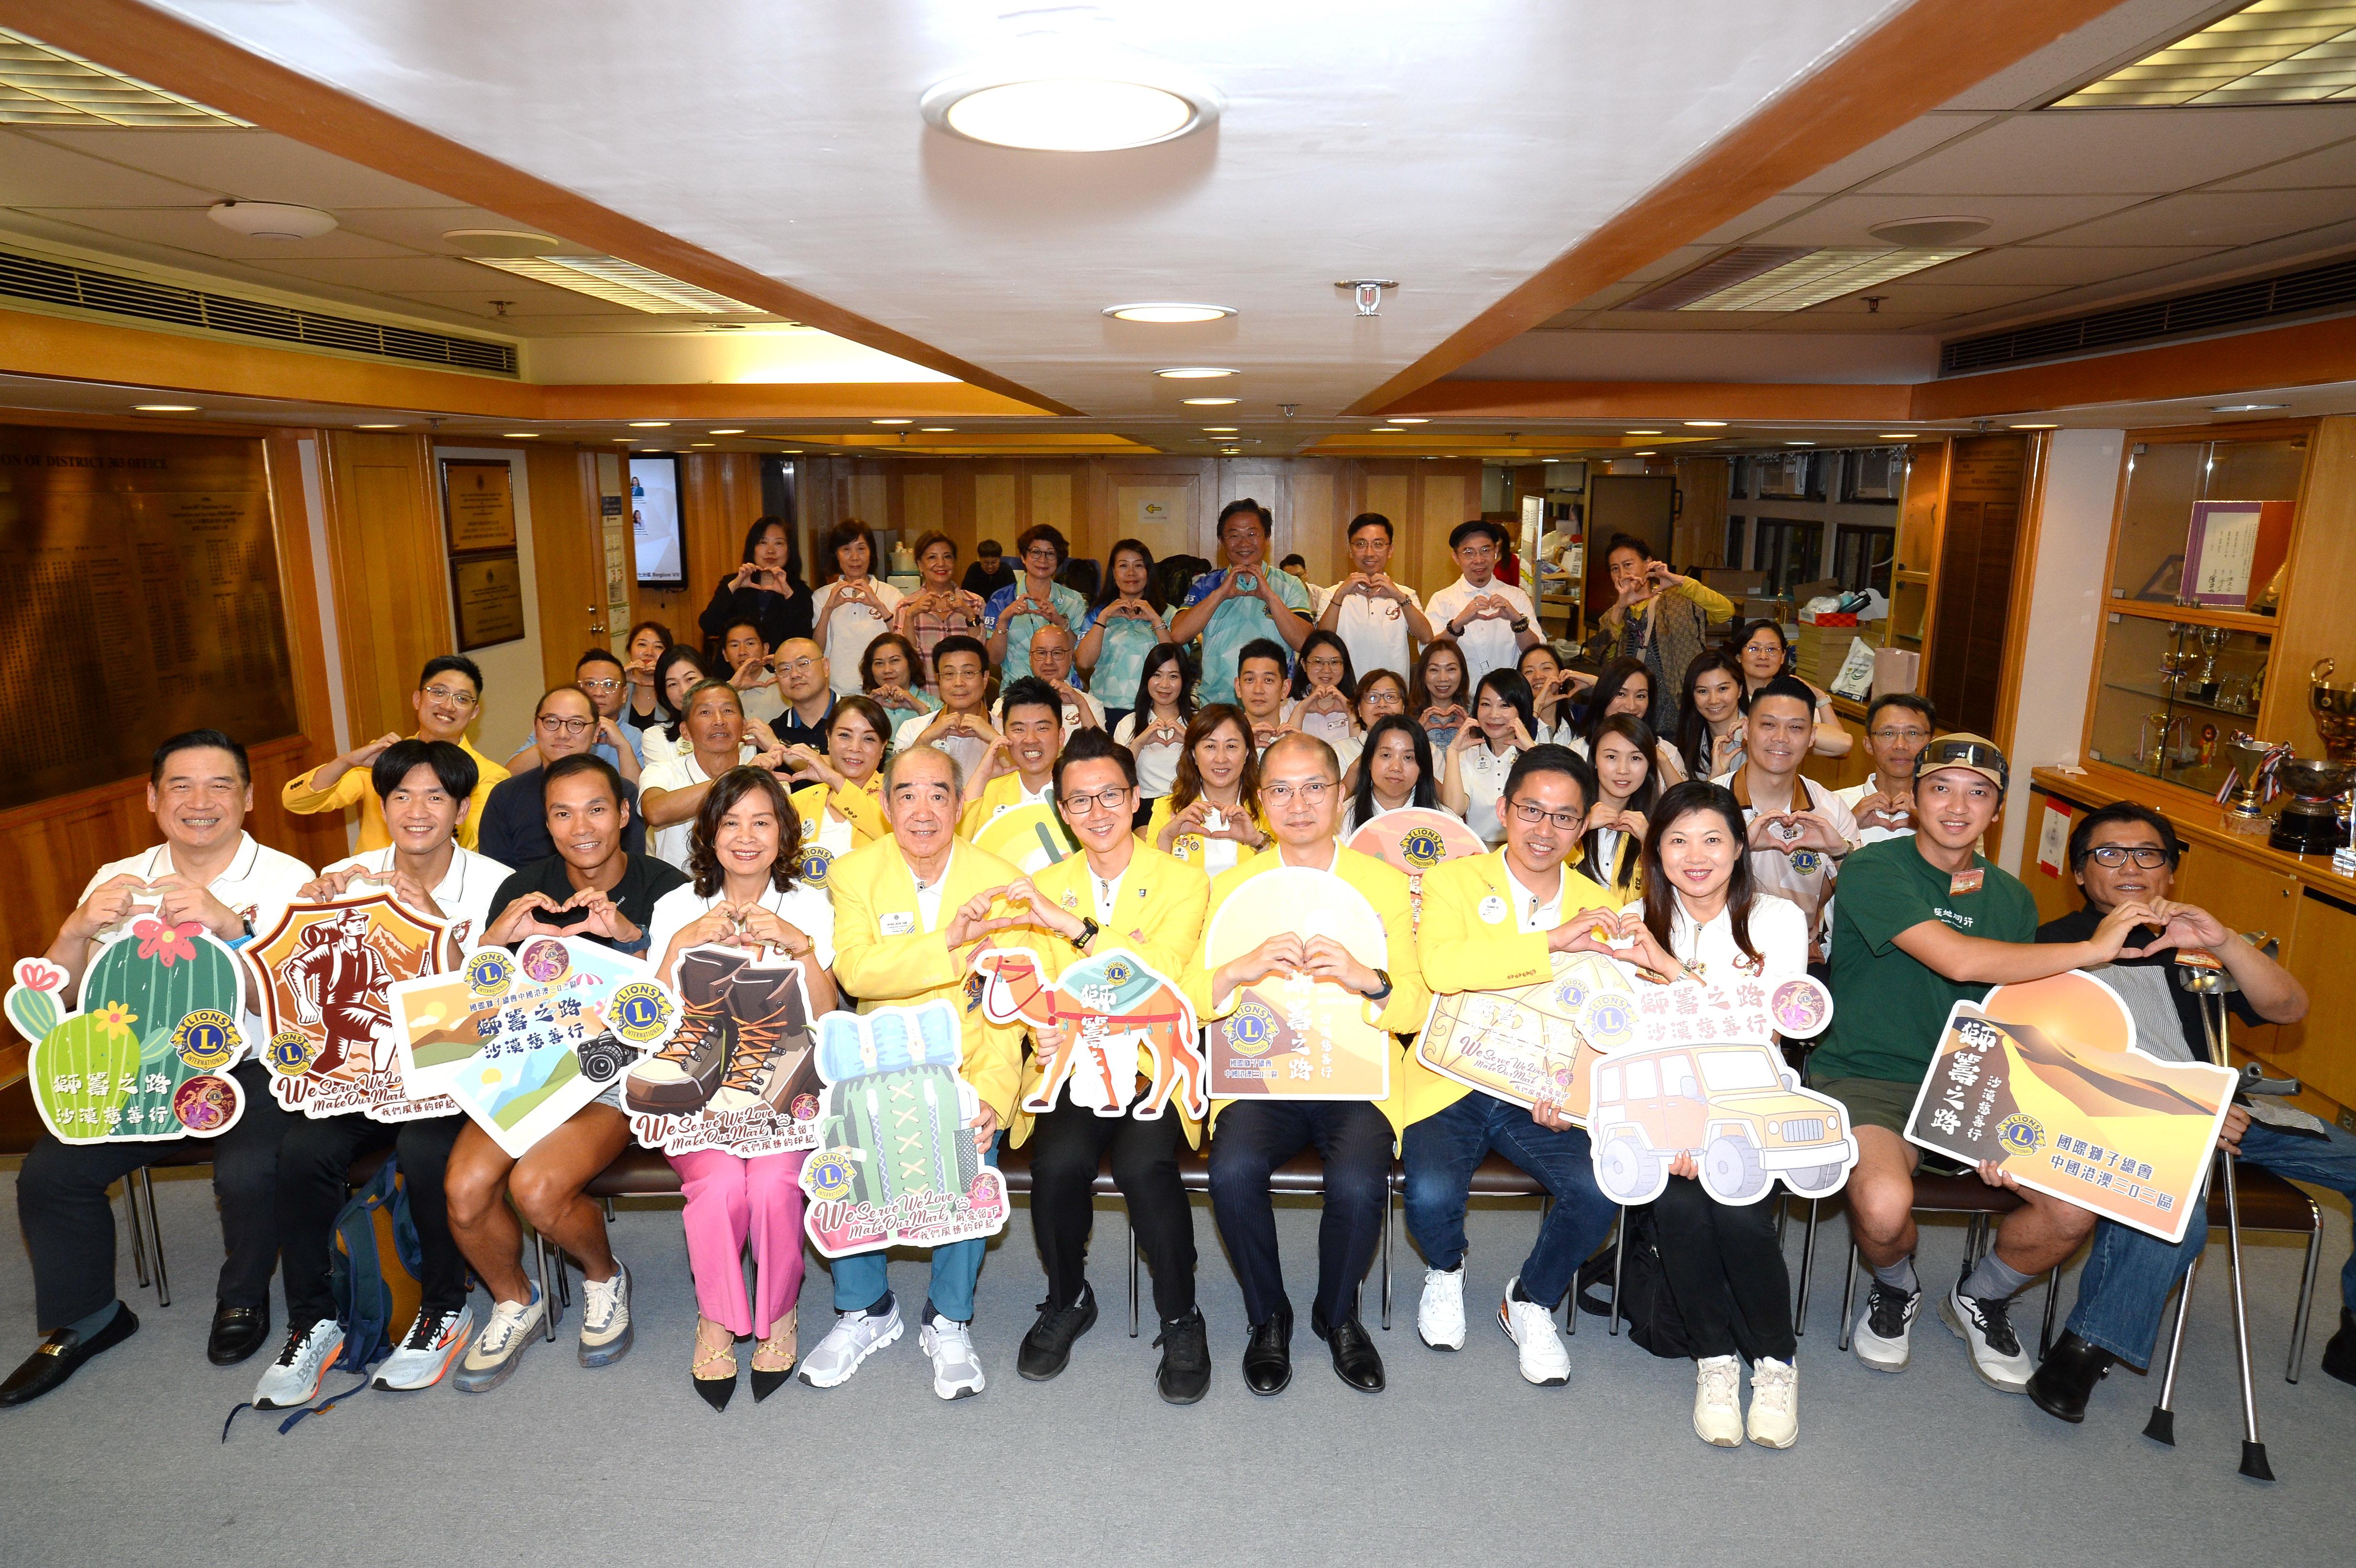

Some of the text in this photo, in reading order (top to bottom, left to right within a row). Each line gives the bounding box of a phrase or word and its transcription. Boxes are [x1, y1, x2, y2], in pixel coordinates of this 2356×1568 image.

[25, 455, 42, 467] OF
[47, 456, 104, 468] DISTRICT
[128, 458, 167, 469] OFFICE
[1413, 829, 1440, 841] LIONS
[1417, 840, 1429, 856] L
[810, 860, 823, 875] L
[1407, 854, 1435, 867] INTERNATIONAL
[471, 953, 502, 966] LIONS
[483, 966, 498, 982] L
[1113, 969, 1122, 978] L
[478, 983, 507, 994] INTERNATIONAL
[619, 985, 656, 1000] LIONS
[1565, 979, 1587, 991] LIONS
[1567, 988, 1578, 1004] L
[1592, 997, 1625, 1008] LIONS
[1640, 982, 1766, 1015] 獅籌之路
[186, 1013, 228, 1025] LIONS
[476, 996, 582, 1037] 獅籌之路
[633, 1002, 652, 1023] L
[1236, 1005, 1266, 1017] LIONS
[1244, 1019, 1259, 1038] L
[1603, 1011, 1620, 1030] L
[1647, 1013, 1767, 1042] 沙漠慈善行
[198, 1029, 217, 1049] L
[273, 1034, 303, 1045] LIONS
[625, 1025, 663, 1038] INTERNATIONAL
[484, 1022, 584, 1059] 沙漠慈善行
[1235, 1043, 1266, 1052] INTERNATIONAL
[185, 1054, 227, 1066] INTERNATIONAL
[285, 1045, 299, 1062] L
[1460, 1036, 1483, 1056] We
[1483, 1049, 1511, 1066] Serve
[1526, 1063, 1546, 1077] Love
[279, 1063, 308, 1074] INTERNATIONAL
[1473, 1059, 1538, 1085] Make Our Mark
[53, 1071, 172, 1097] 獅籌之路
[1931, 1021, 1997, 1135] 獅籌之路
[277, 1071, 403, 1104] We Serve We Lo
[313, 1095, 346, 1113] Make
[344, 1091, 372, 1106] Our
[381, 1100, 456, 1117] 我們服務的印記
[1967, 1075, 2002, 1142] 沙漠慈善行
[55, 1105, 169, 1125] 沙漠慈善行
[2012, 1115, 2040, 1130] LIONS
[636, 1107, 775, 1143] We Serve We Love
[671, 1120, 768, 1151] Make Our Mark
[2014, 1126, 2028, 1143] L
[741, 1134, 815, 1153] 我們服務的印記
[813, 1155, 844, 1166] LIONS
[2056, 1133, 2153, 1180] 國際獅子總會
[823, 1167, 839, 1185] L
[817, 1186, 848, 1198] INTERNATIONAL
[814, 1190, 955, 1231] We Serve We Love
[956, 1205, 1000, 1224] 用愛留下
[849, 1204, 947, 1240] Make Our Mark
[919, 1219, 996, 1240] 我們服務的印記
